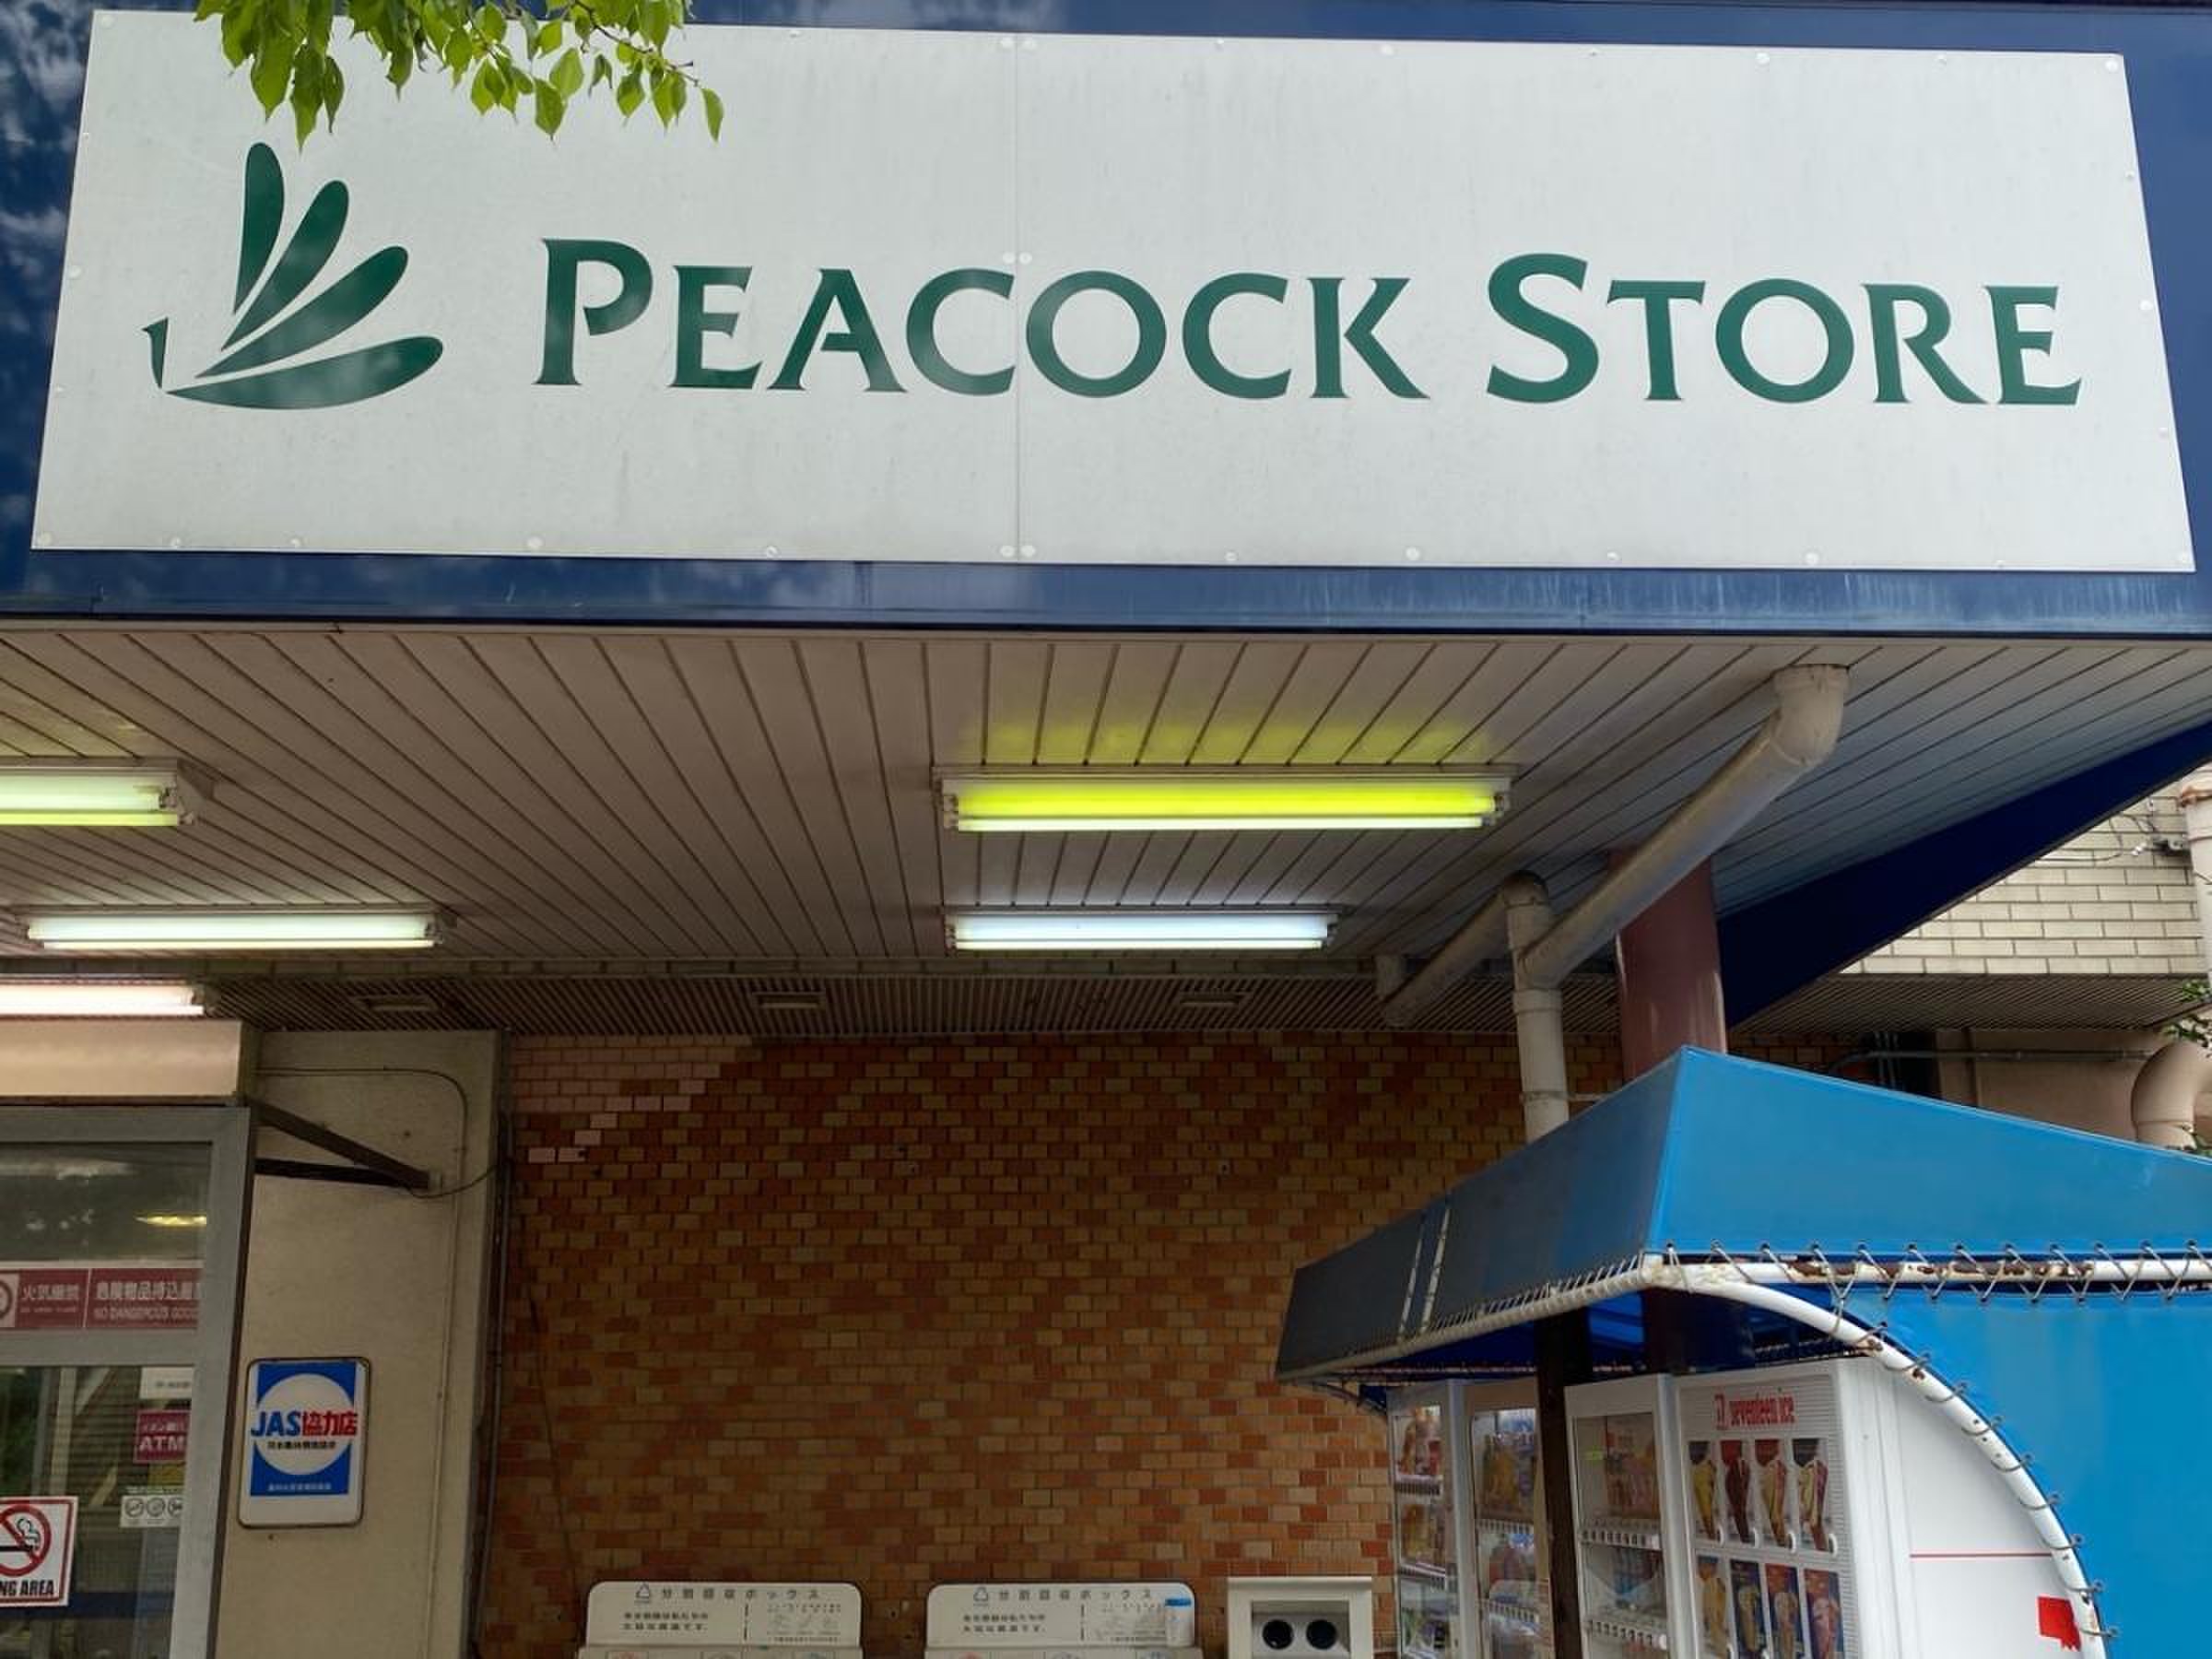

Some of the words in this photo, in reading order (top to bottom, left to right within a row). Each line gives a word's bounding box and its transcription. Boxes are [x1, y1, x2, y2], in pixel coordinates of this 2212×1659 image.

[534, 239, 1428, 399] PEACOCK
[1487, 253, 2081, 406] STORE
[250, 1410, 359, 1437] JAS協力店
[139, 1436, 185, 1452] ATM
[19, 1579, 55, 1596] AREA
